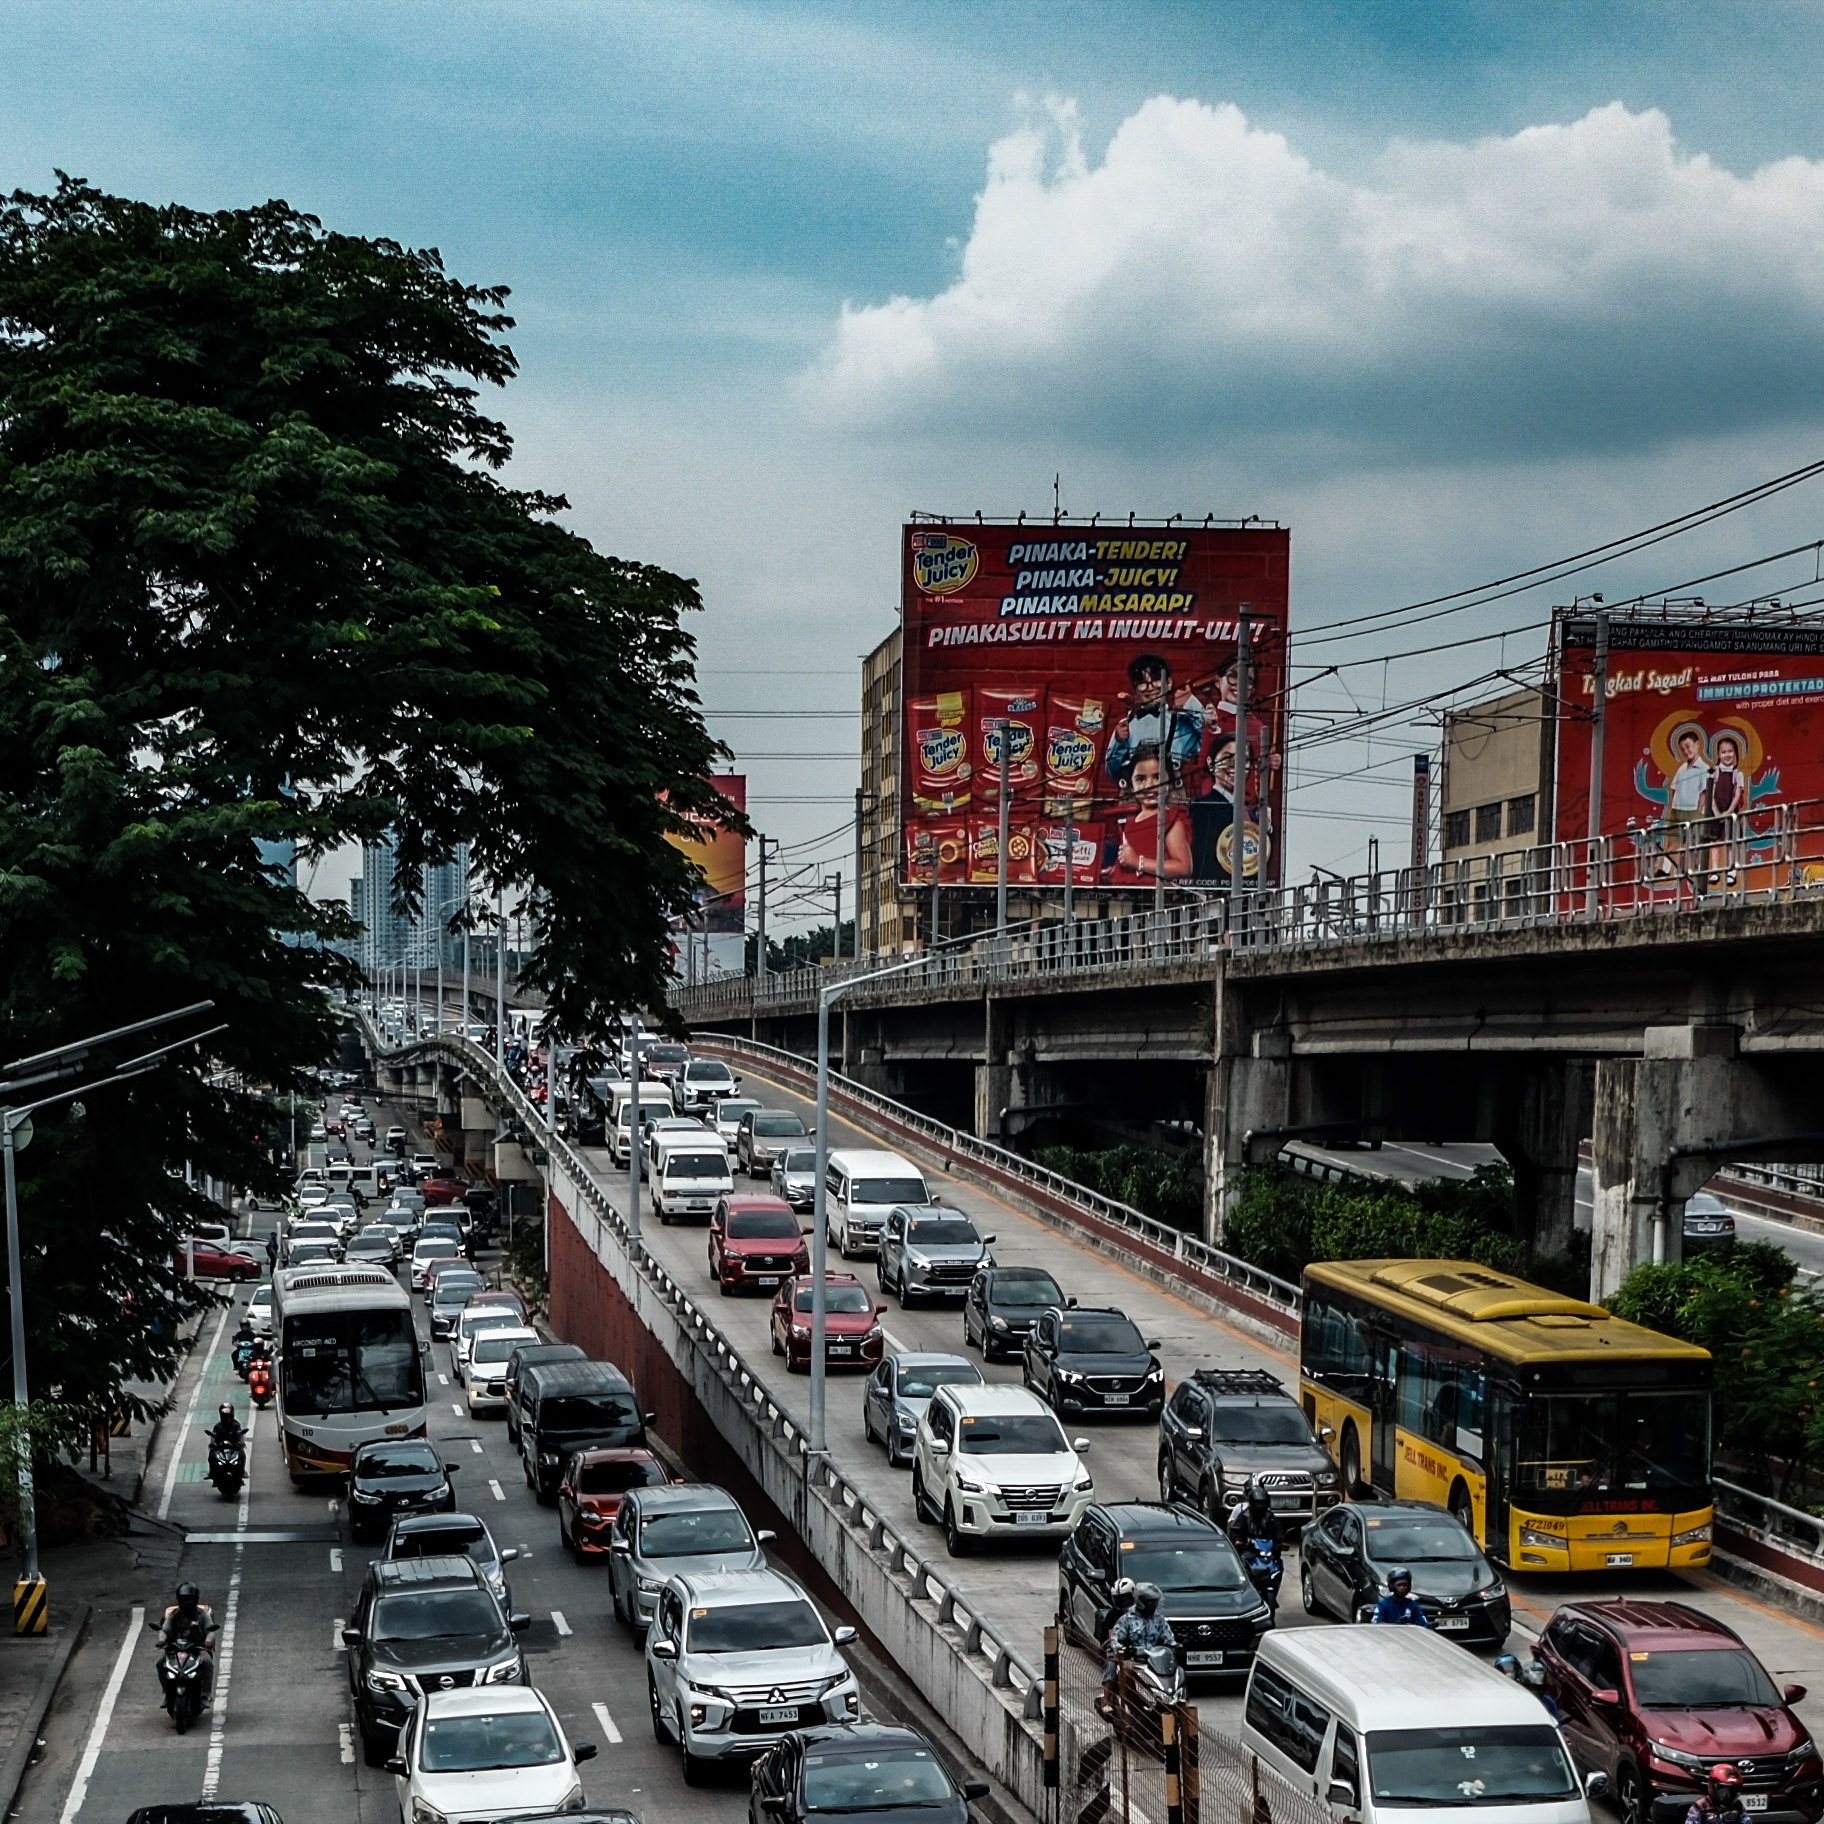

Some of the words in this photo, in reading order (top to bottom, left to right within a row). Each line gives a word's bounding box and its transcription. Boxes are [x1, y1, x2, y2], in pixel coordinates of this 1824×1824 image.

[917, 545, 976, 571] Tender
[1008, 541, 1187, 564] PINAKA-TENDER!
[922, 562, 968, 587] Juicy
[1016, 568, 1179, 590] PINAKA-JUICY!
[928, 621, 1071, 648] PINAKASULIT
[1073, 620, 1103, 639] NA
[1582, 670, 1644, 698] Tagkad
[1646, 667, 1693, 695] Sagad!
[923, 733, 962, 758] Tender
[987, 727, 1031, 748] Teder
[1051, 741, 1094, 757] Tender
[930, 747, 960, 770] Juicy
[779, 1709, 798, 1719] 7453
